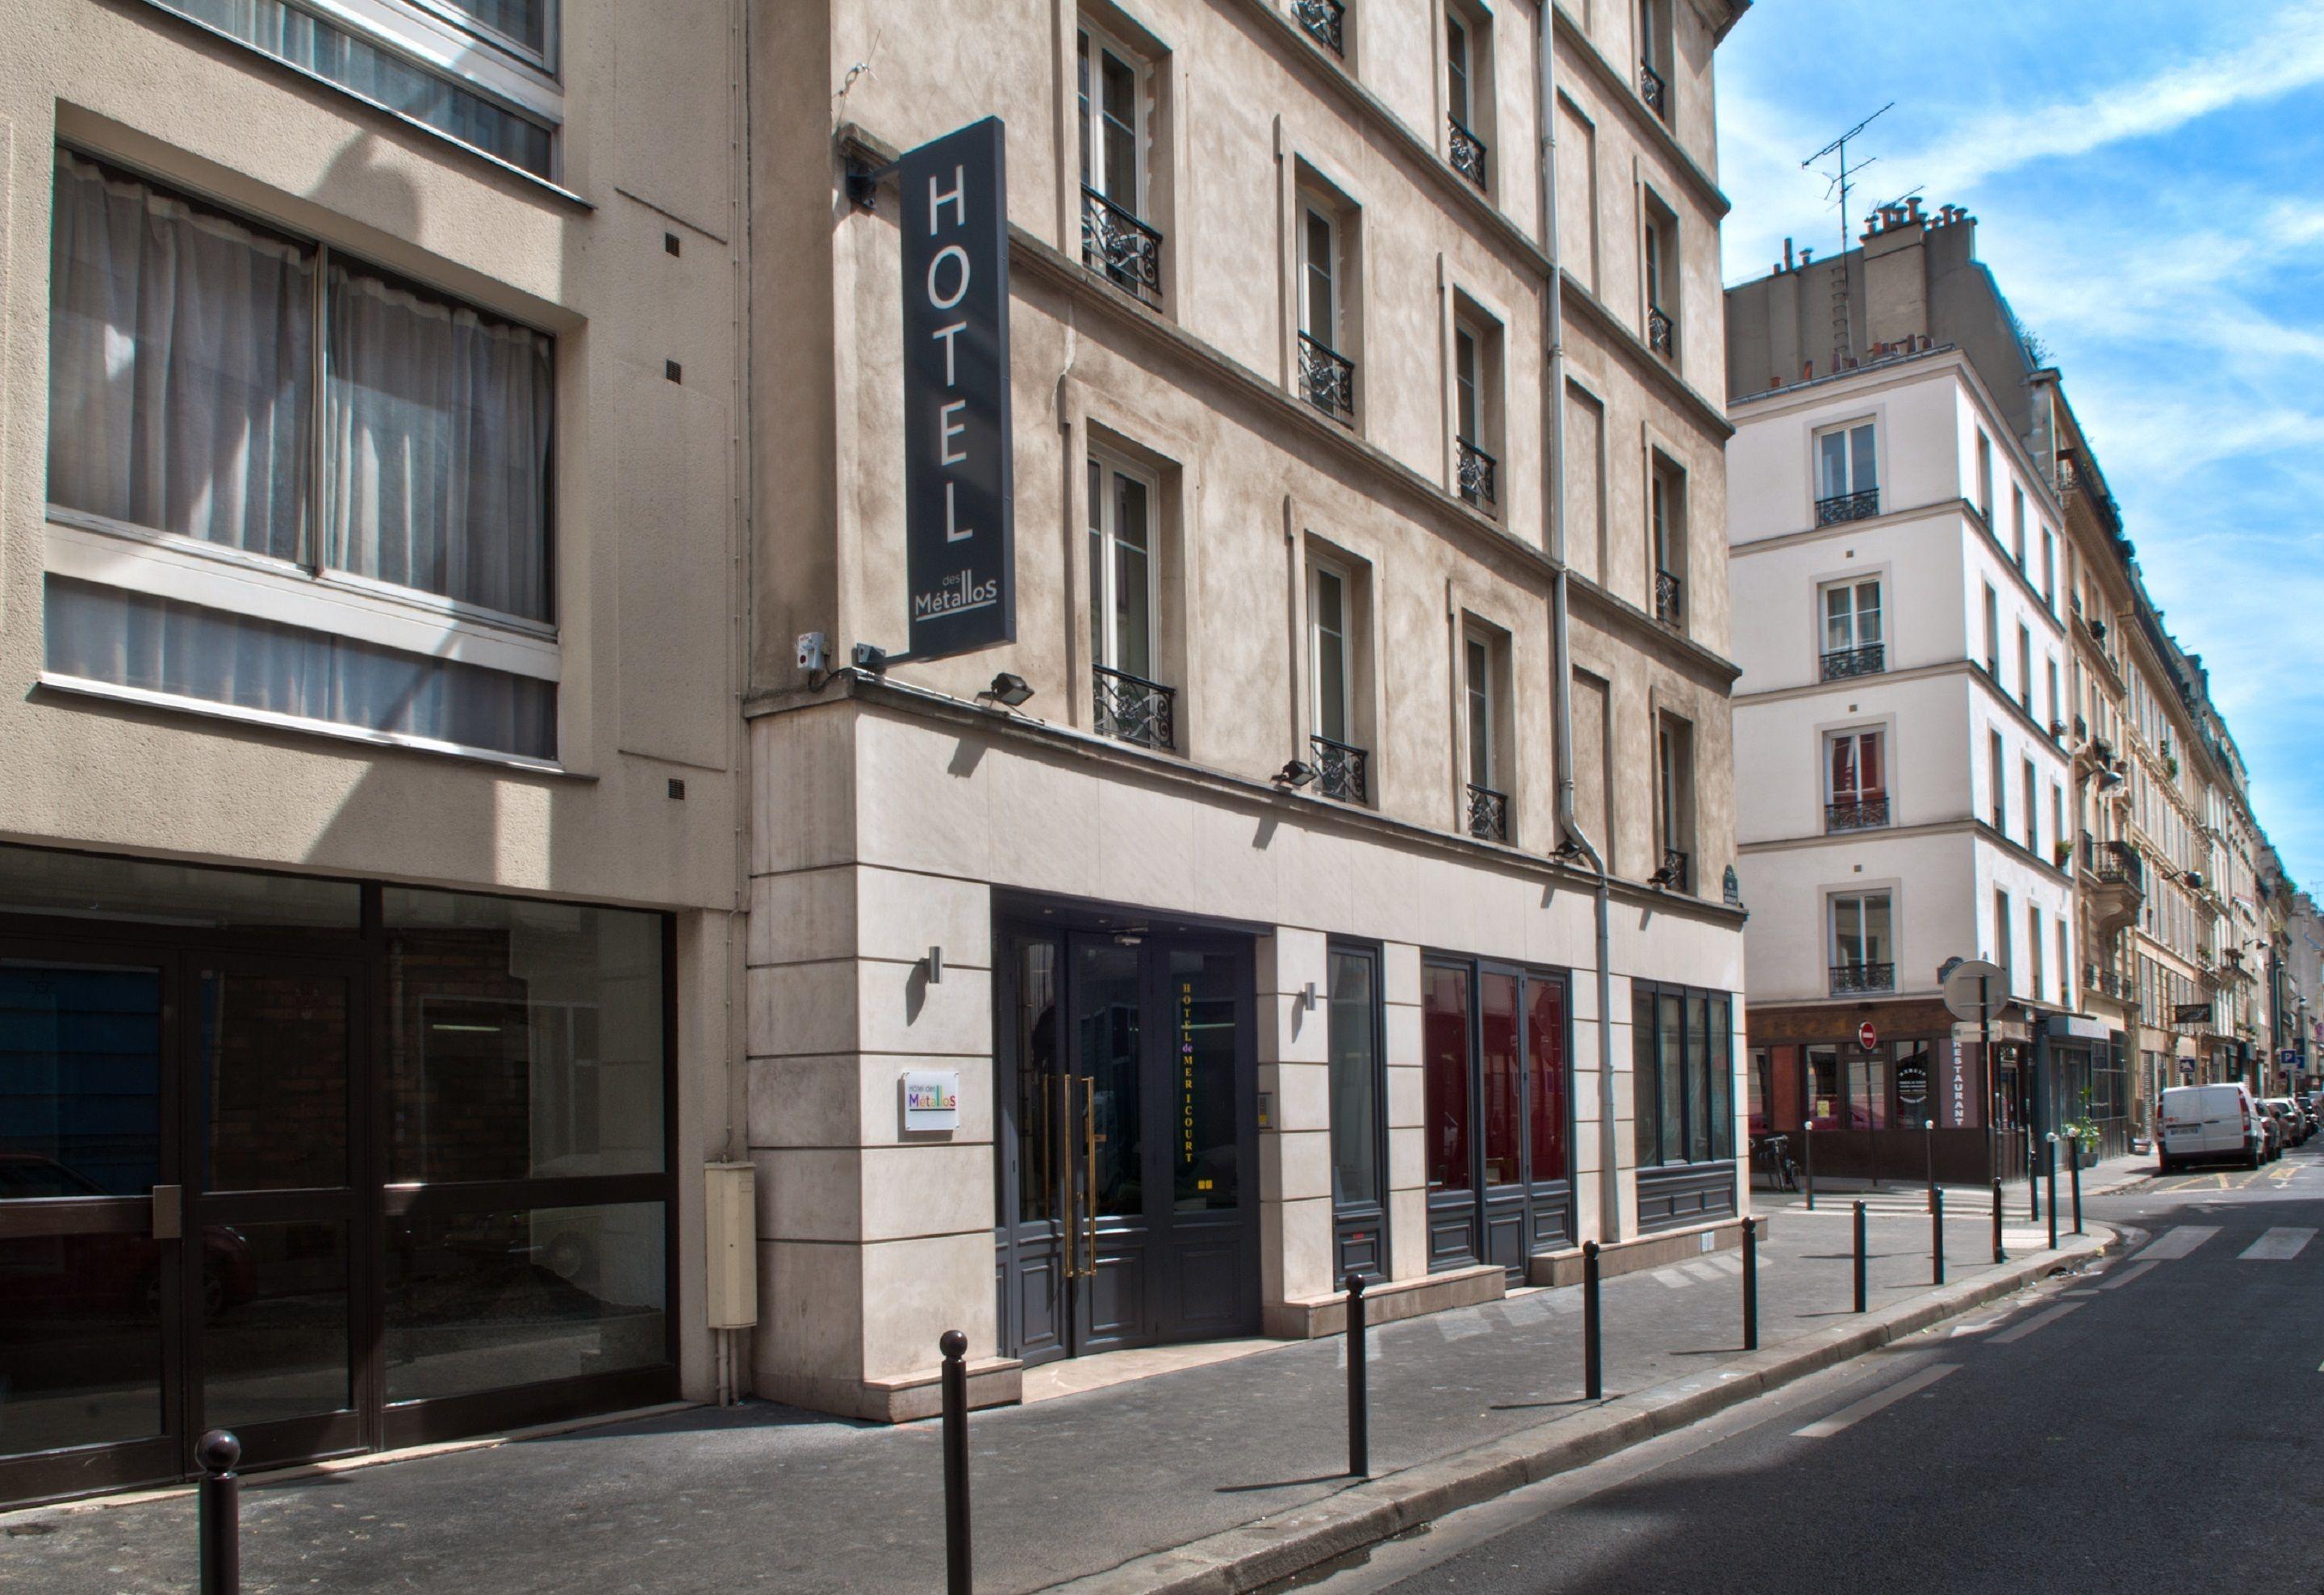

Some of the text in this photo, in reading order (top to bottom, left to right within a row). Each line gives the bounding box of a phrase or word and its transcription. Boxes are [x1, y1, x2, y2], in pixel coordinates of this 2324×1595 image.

[927, 165, 973, 543] HOTEL
[916, 569, 997, 616] Métallos
[943, 575, 961, 586] des
[909, 1085, 956, 1107] Métallos
[1182, 983, 1193, 1162] HOTEL de MERICOURT
[1953, 1040, 1963, 1125] RESTAURANT
